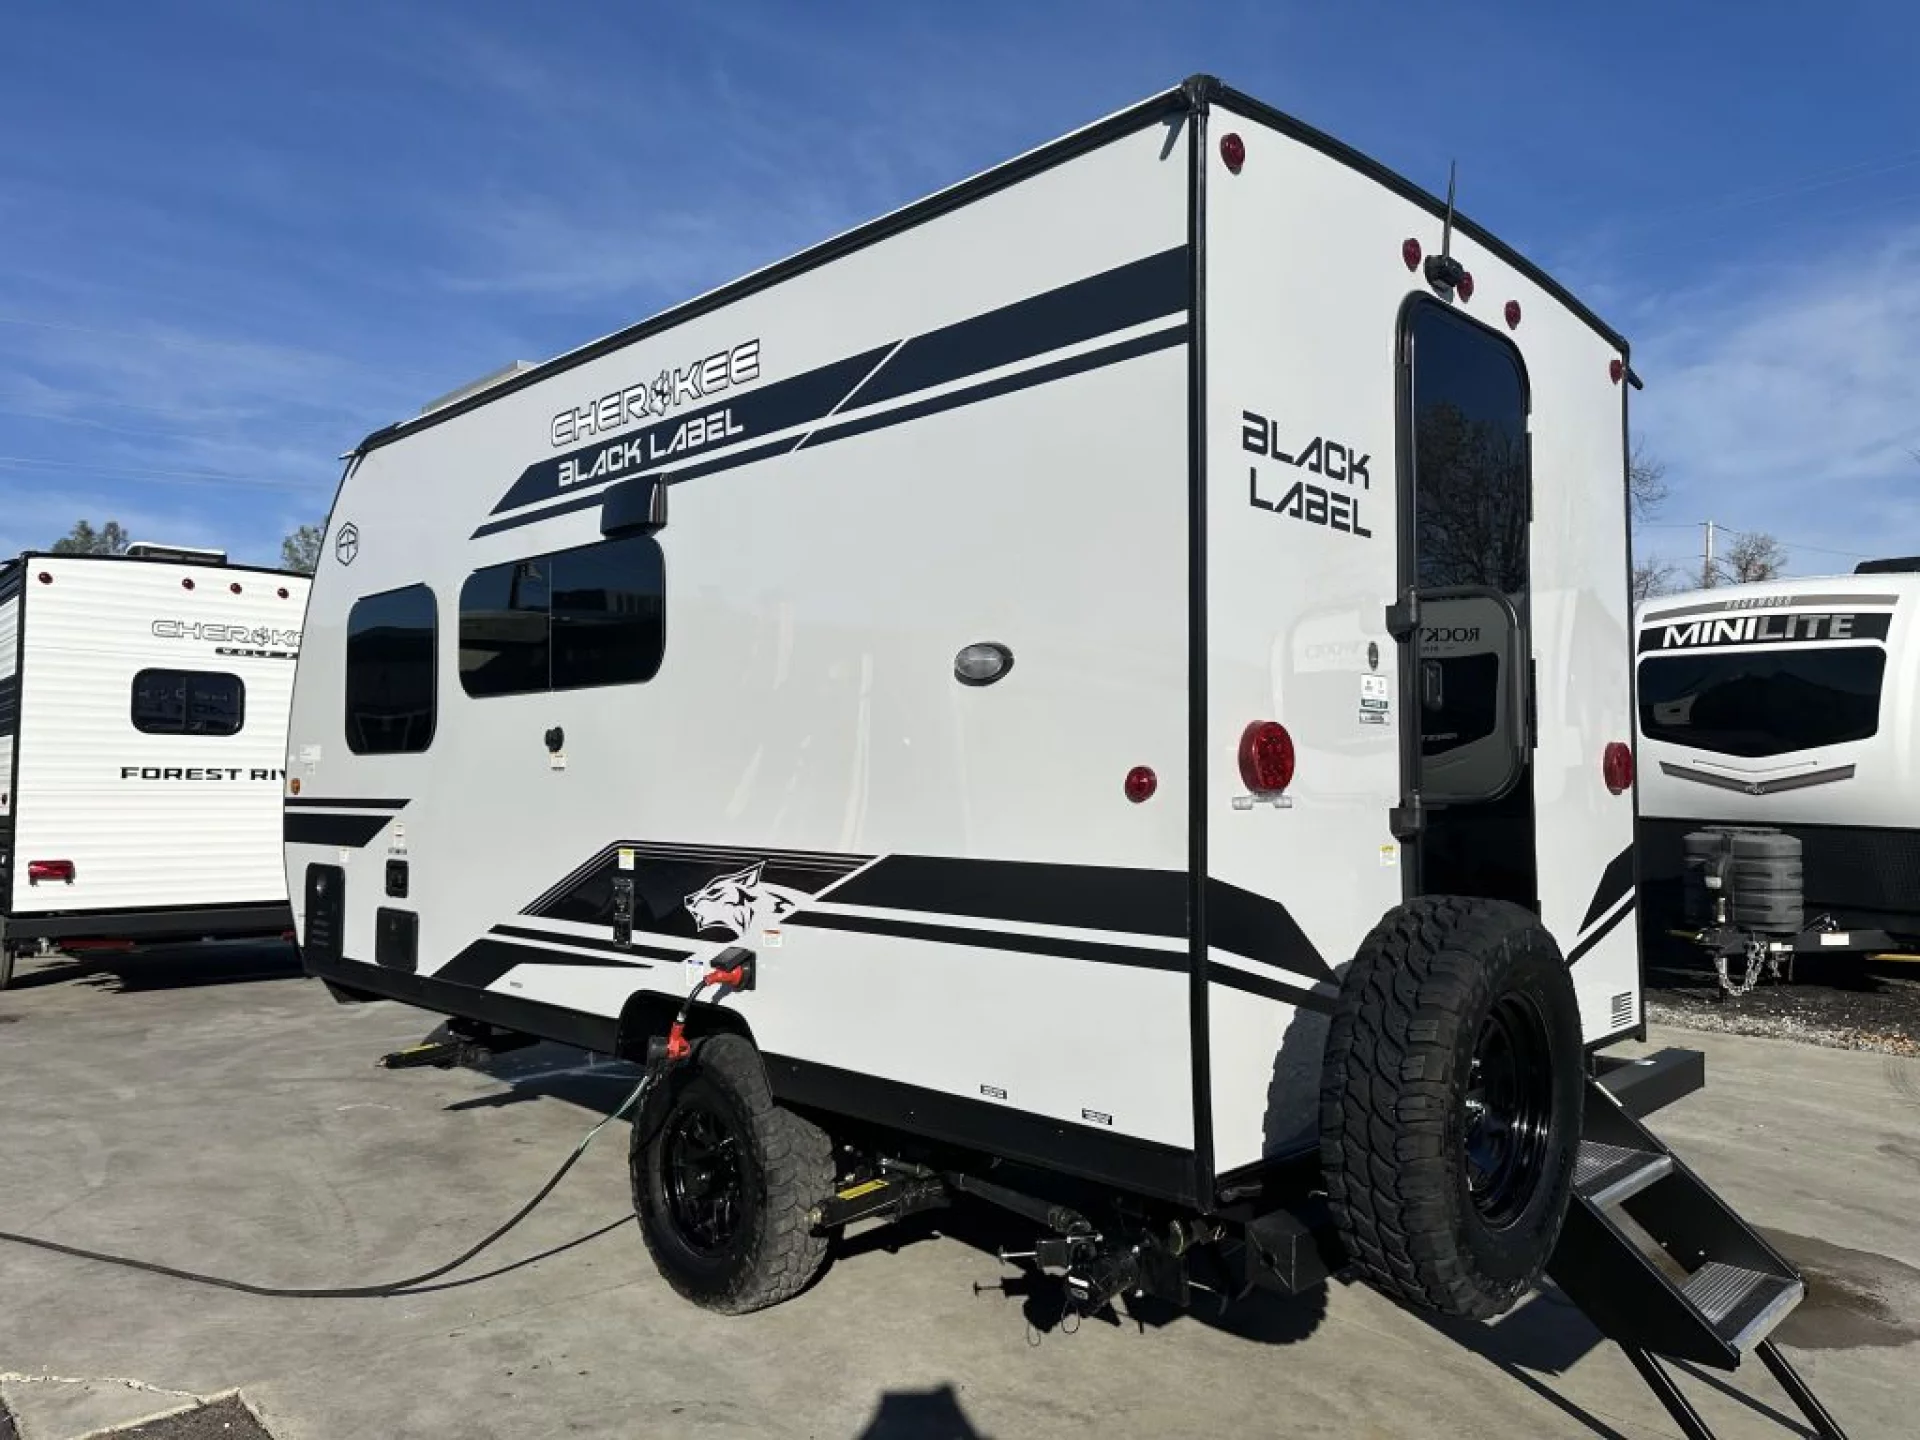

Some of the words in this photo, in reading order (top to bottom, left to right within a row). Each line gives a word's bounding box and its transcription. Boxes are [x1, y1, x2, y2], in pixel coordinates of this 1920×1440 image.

[551, 338, 760, 447] CHEROKEE
[558, 438, 641, 487] BLACK
[650, 408, 744, 459] LABEL
[1242, 409, 1371, 490] BLACK
[1250, 466, 1371, 538] LABEL
[120, 766, 242, 781] FOREST
